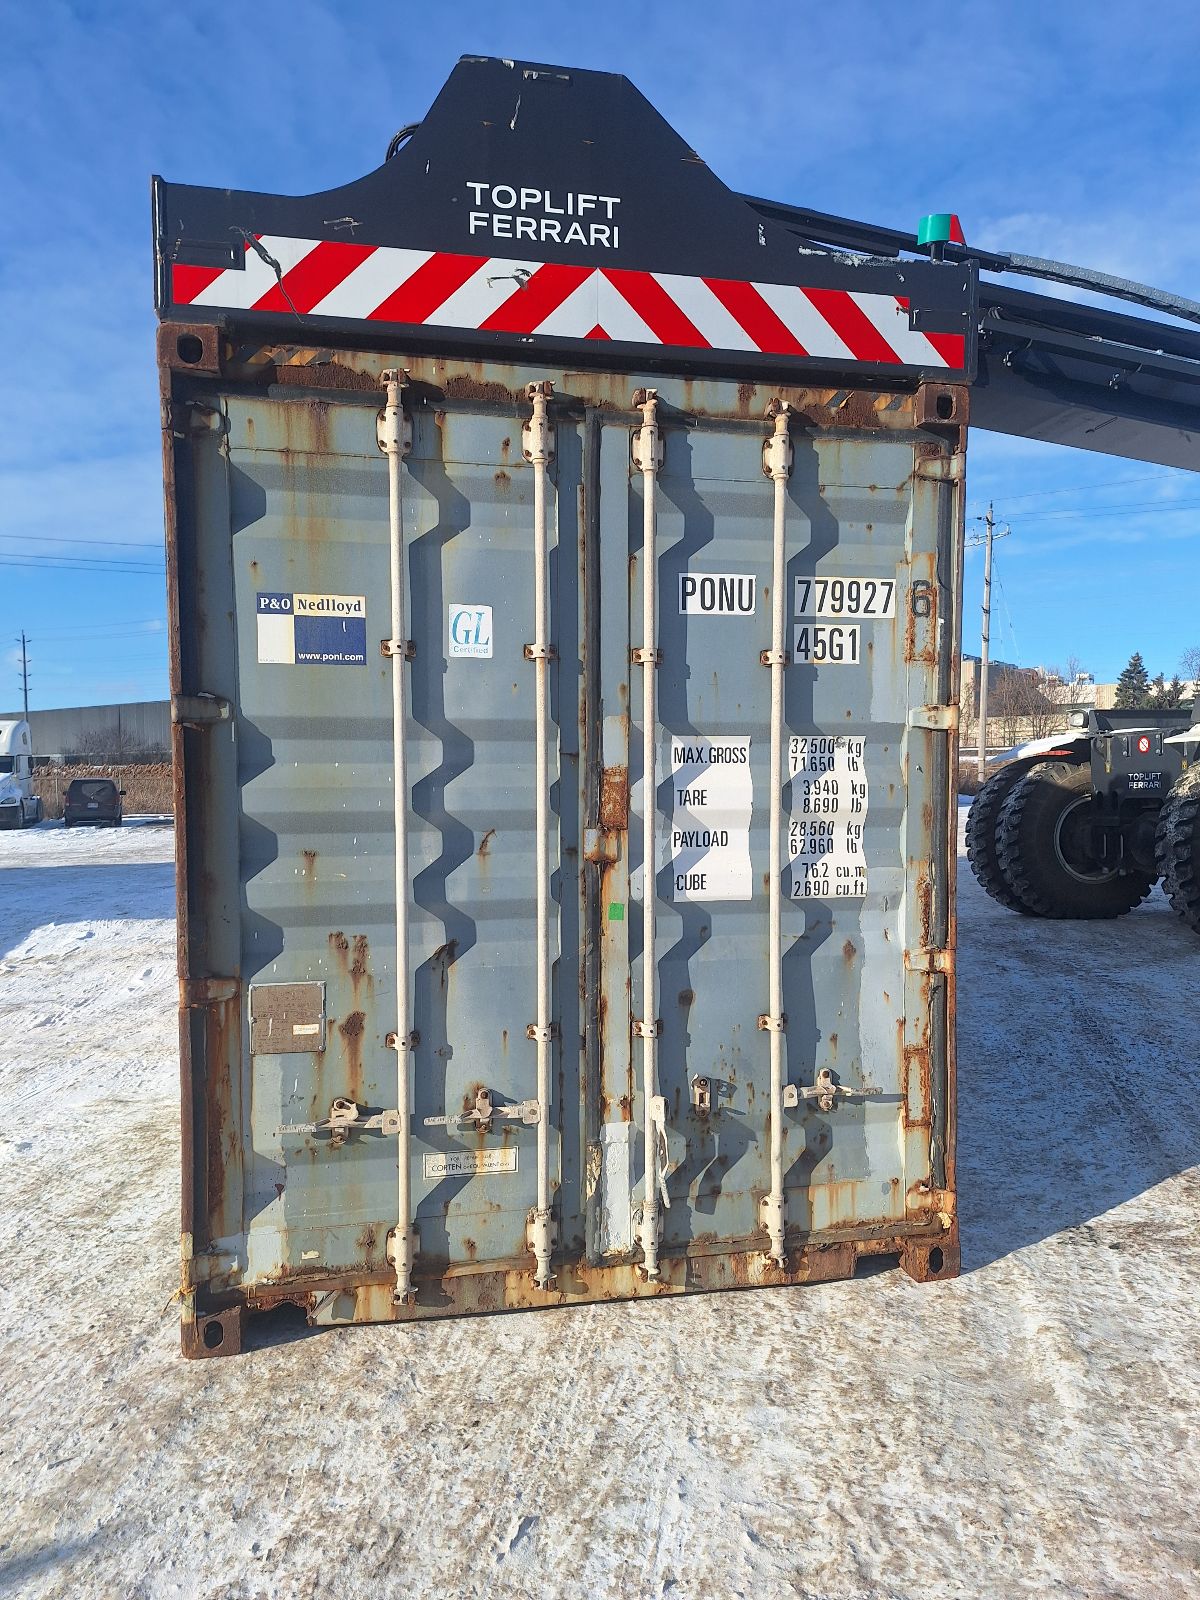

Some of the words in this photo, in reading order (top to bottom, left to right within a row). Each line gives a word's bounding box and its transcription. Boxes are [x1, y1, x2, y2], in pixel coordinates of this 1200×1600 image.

[466, 181, 621, 219] TOPLIFT
[469, 211, 619, 249] FERRARI
[259, 597, 291, 610] P&O
[297, 598, 362, 615] Nedlloyd
[681, 576, 754, 612] PONU
[797, 579, 894, 614] 779927
[911, 580, 931, 617] 6
[452, 610, 490, 645] GL
[796, 627, 857, 661] 45G1
[297, 652, 364, 662] www.ponl.com
[847, 738, 862, 758] kg
[847, 756, 859, 772] lb
[1127, 772, 1162, 781] TOPLIFT
[1128, 781, 1162, 790] FERRARI
[676, 789, 708, 807] TARE
[850, 779, 866, 799] kg
[850, 797, 862, 814] lb
[673, 830, 729, 848] PAYLOAD
[846, 820, 862, 840] kg
[846, 837, 858, 854] lb
[675, 873, 707, 891] CUBE
[801, 862, 829, 879] 76.2
